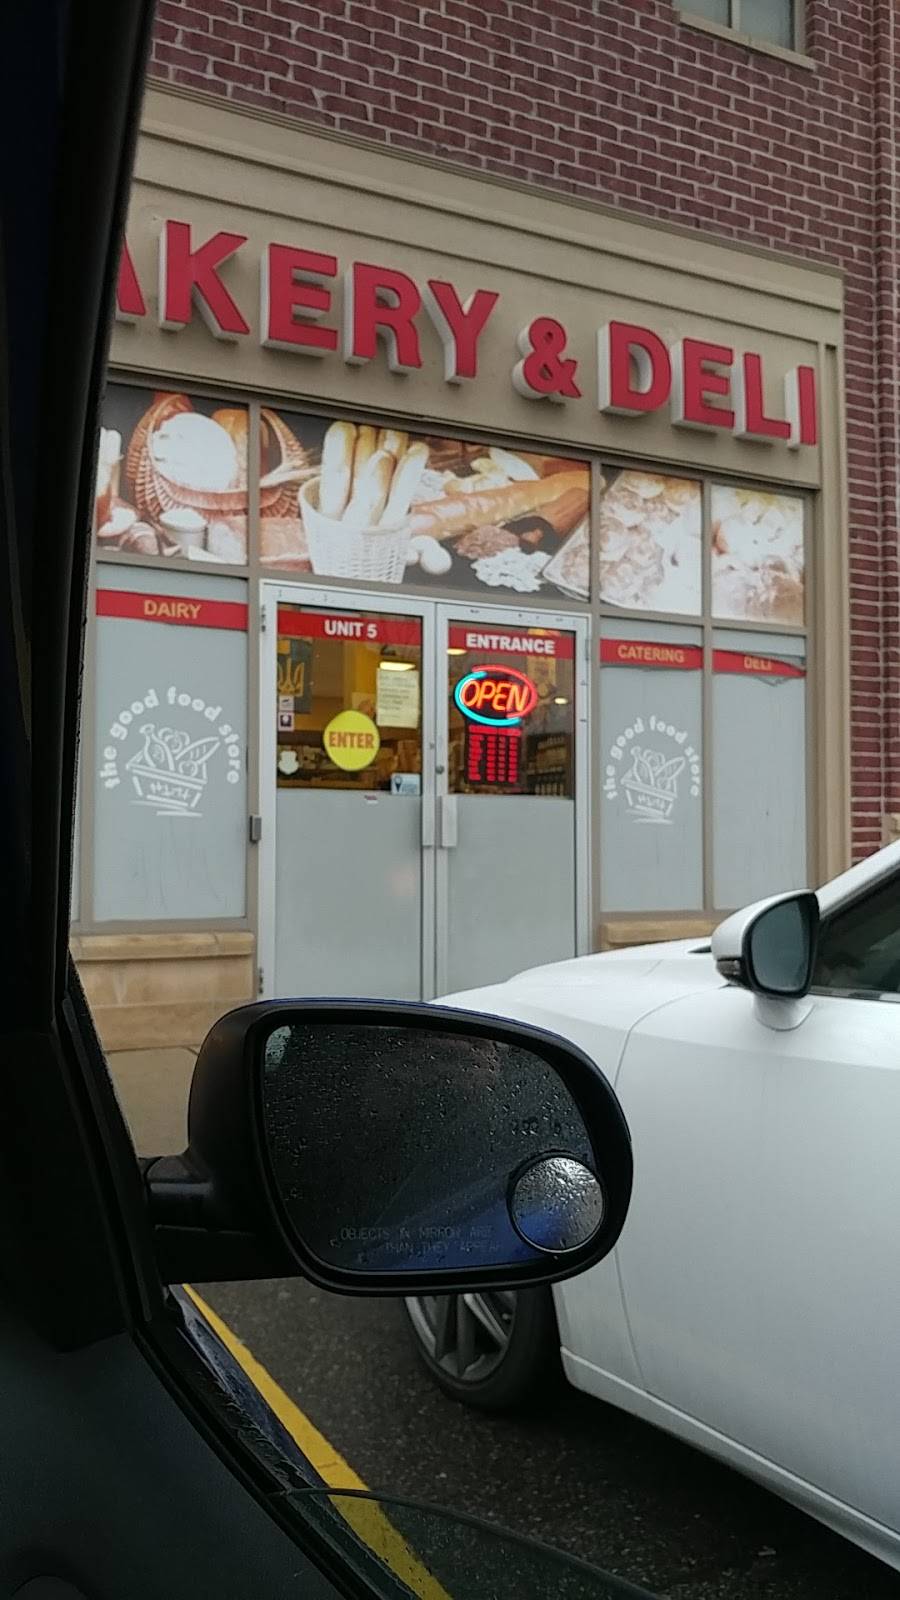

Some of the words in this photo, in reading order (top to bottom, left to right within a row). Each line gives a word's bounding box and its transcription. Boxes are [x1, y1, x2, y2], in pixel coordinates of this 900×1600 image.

[517, 316, 582, 400] &
[602, 320, 817, 448] DELI
[143, 599, 202, 620] DAIRY
[324, 619, 364, 637] UNIT
[366, 623, 378, 639] 5
[465, 633, 556, 655] ENTRANCE
[617, 644, 685, 664] CATERING
[743, 656, 773, 671] DELI
[166, 686, 223, 723] food
[461, 678, 529, 712] OPEN
[109, 688, 160, 741] good
[649, 715, 689, 745] food
[218, 723, 241, 785] store
[328, 730, 375, 750] ENTER
[610, 717, 645, 761] good
[99, 746, 121, 789] the
[603, 764, 618, 801] the
[684, 745, 701, 798] store
[340, 1226, 392, 1241] OBJECTS
